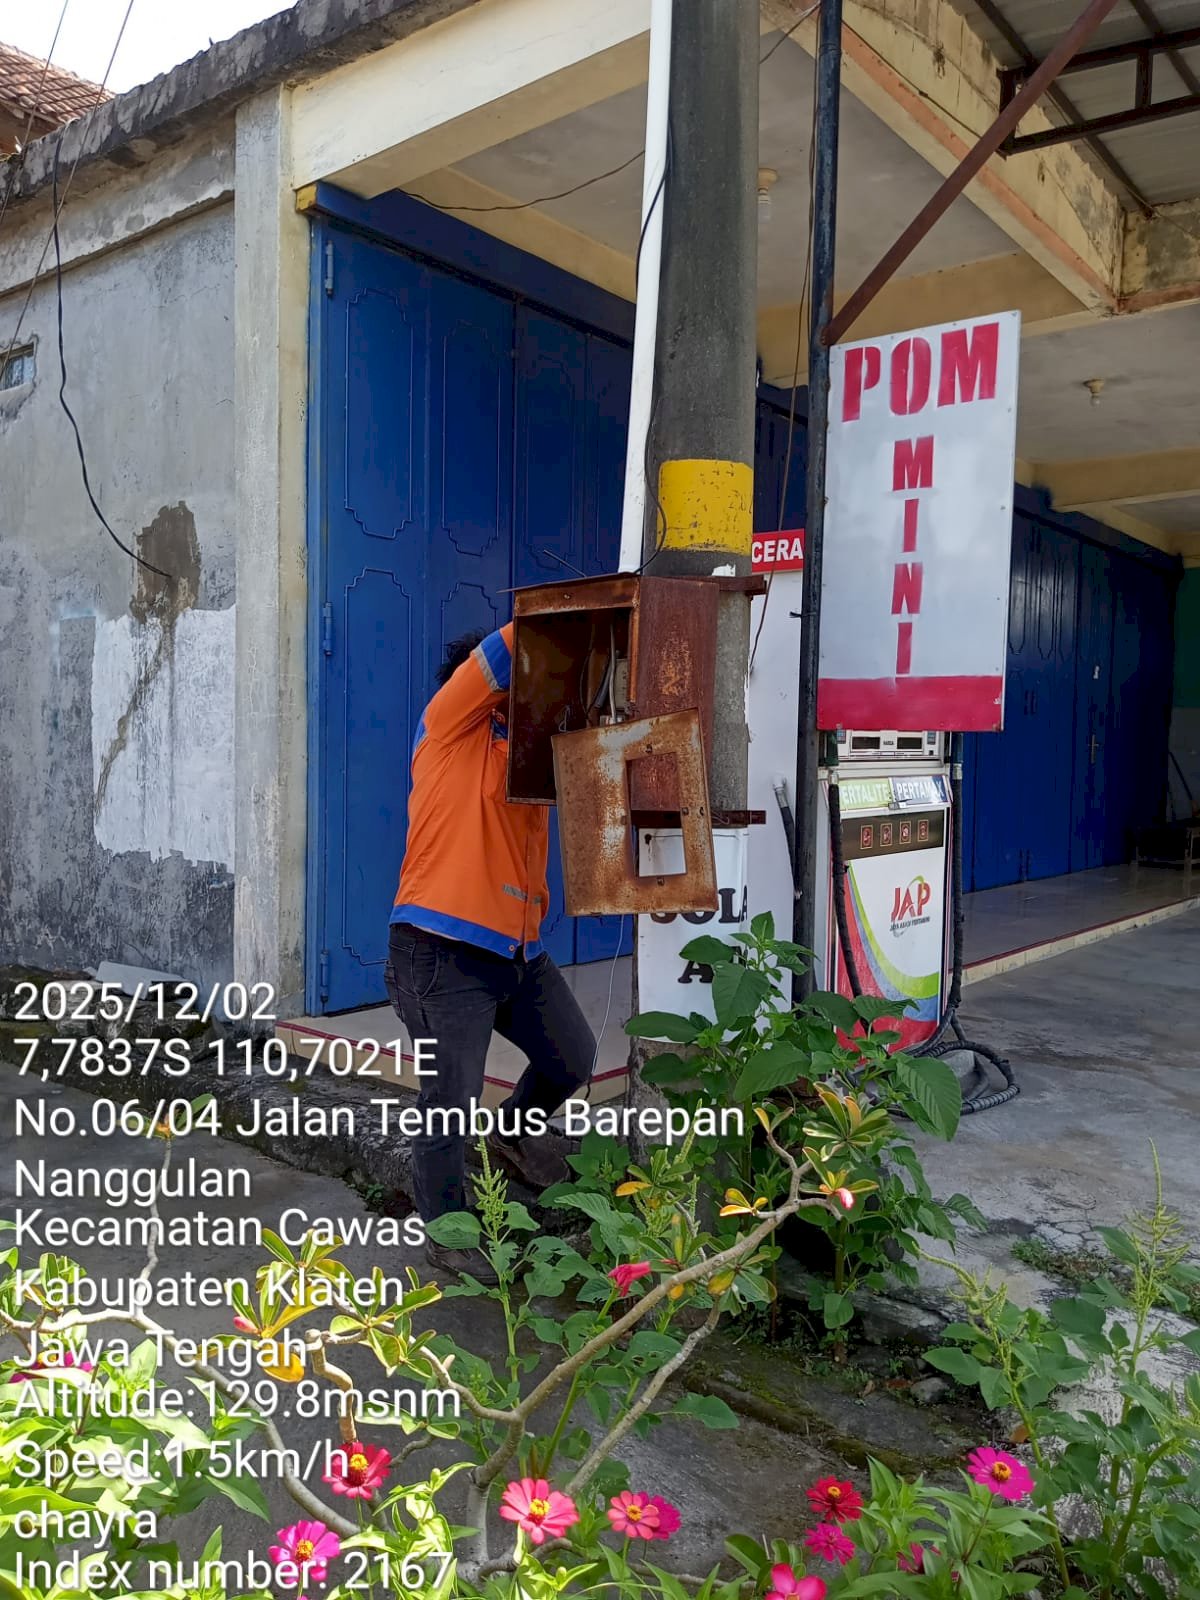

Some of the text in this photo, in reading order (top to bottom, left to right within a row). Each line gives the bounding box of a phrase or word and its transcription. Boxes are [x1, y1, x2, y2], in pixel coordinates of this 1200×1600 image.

[842, 322, 1000, 423] POM
[891, 435, 935, 675] MINI
[840, 780, 945, 804] ERTALITE PERTAMAX
[891, 882, 931, 922] JAP
